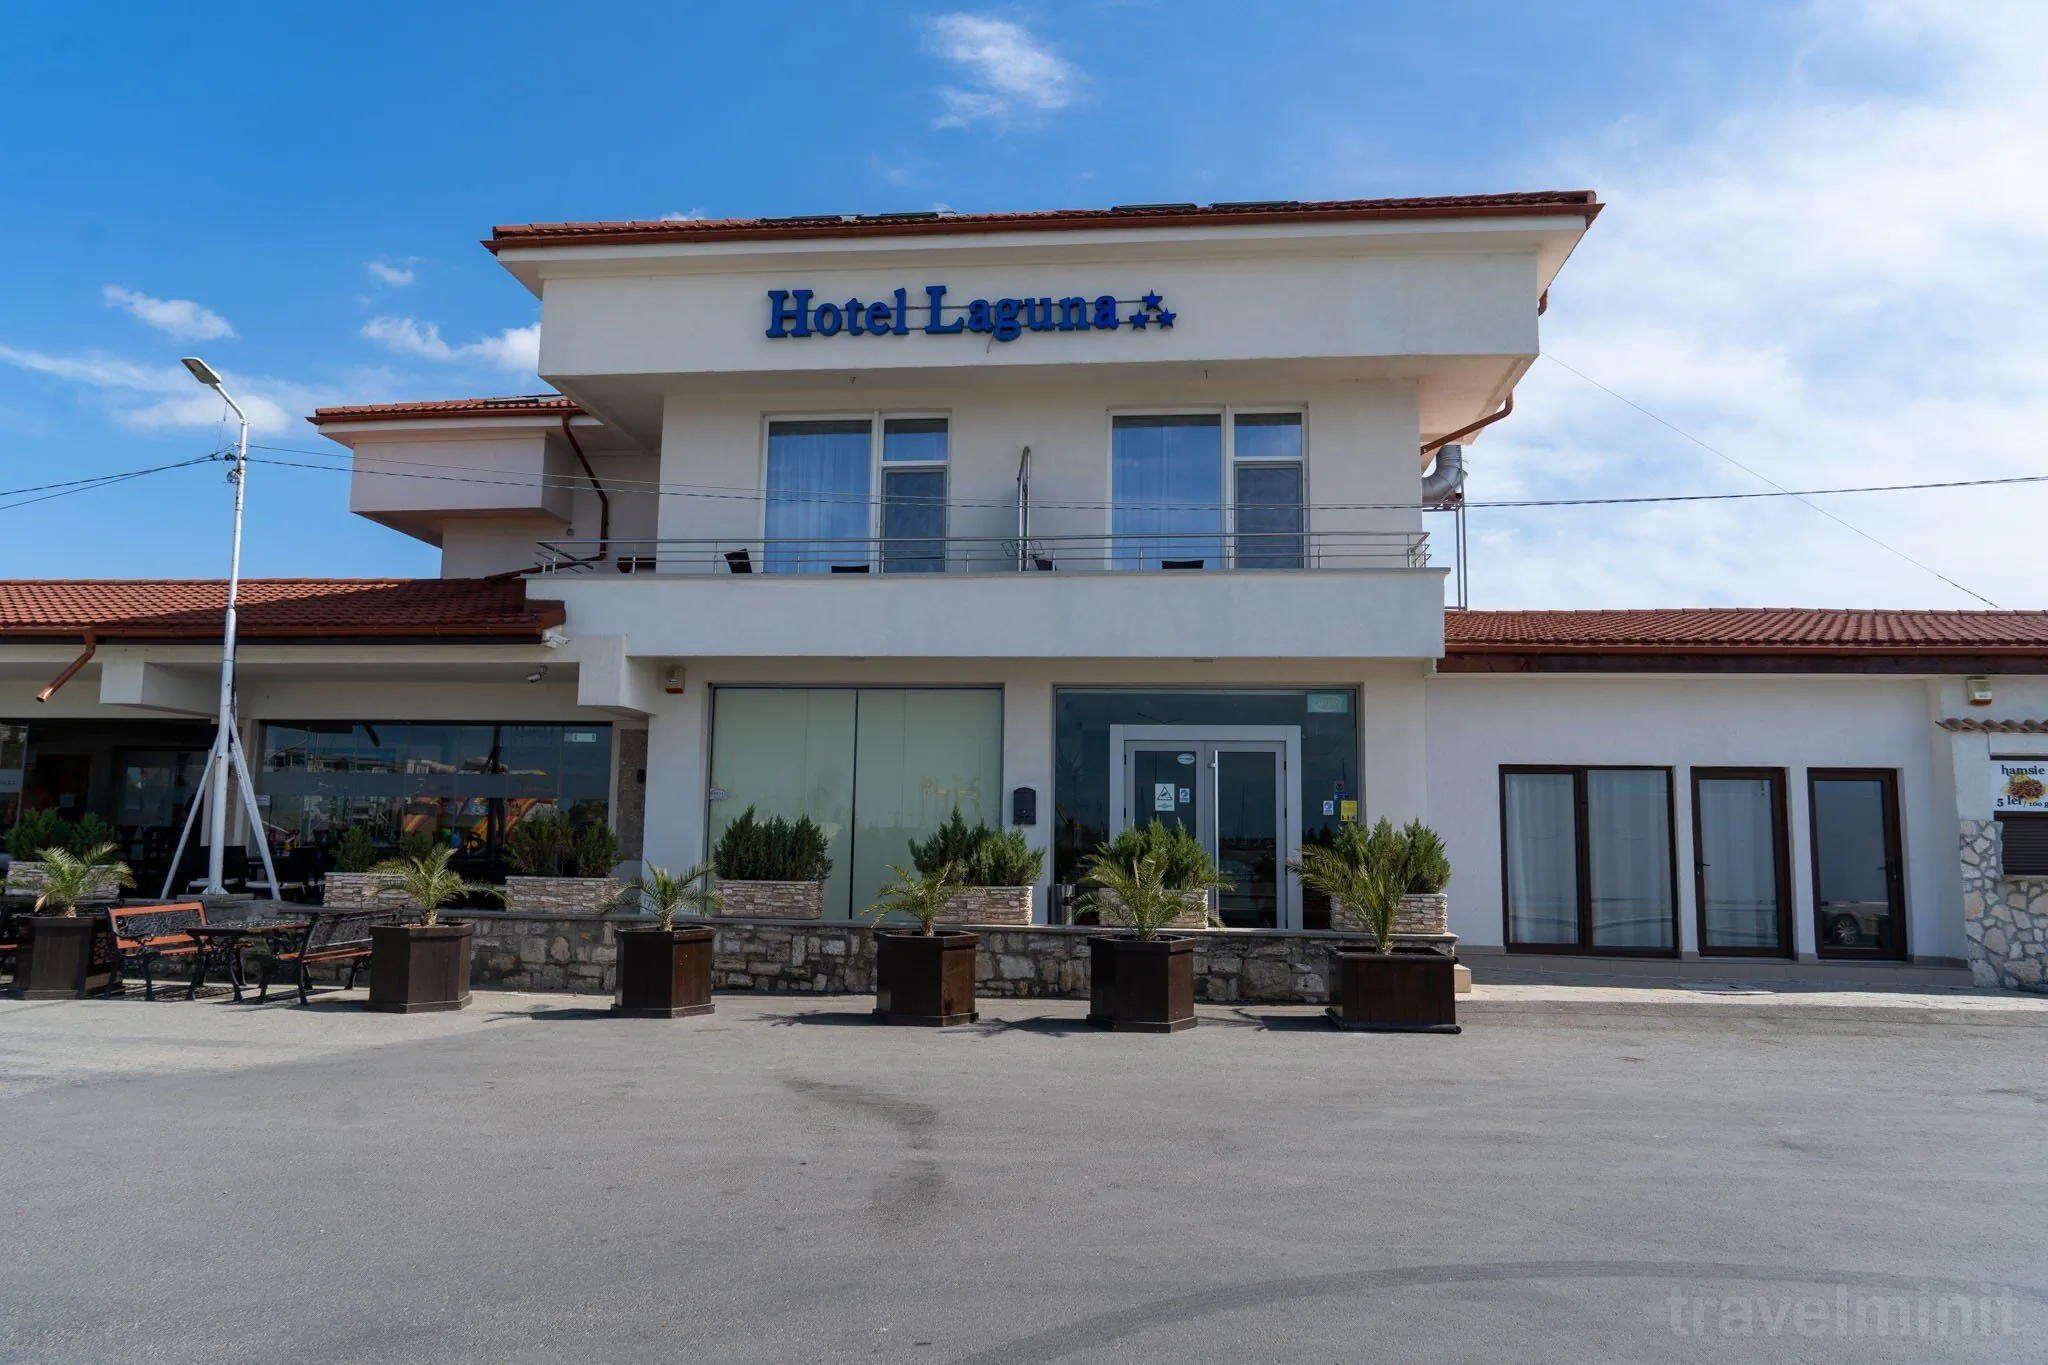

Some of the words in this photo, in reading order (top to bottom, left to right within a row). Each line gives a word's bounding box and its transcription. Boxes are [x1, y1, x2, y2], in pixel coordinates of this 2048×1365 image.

[766, 287, 910, 338] Hotel
[924, 285, 1120, 341] Laguna
[2001, 764, 2045, 776] hamsie
[1997, 798, 2004, 807] 5
[2007, 795, 2022, 805] lei
